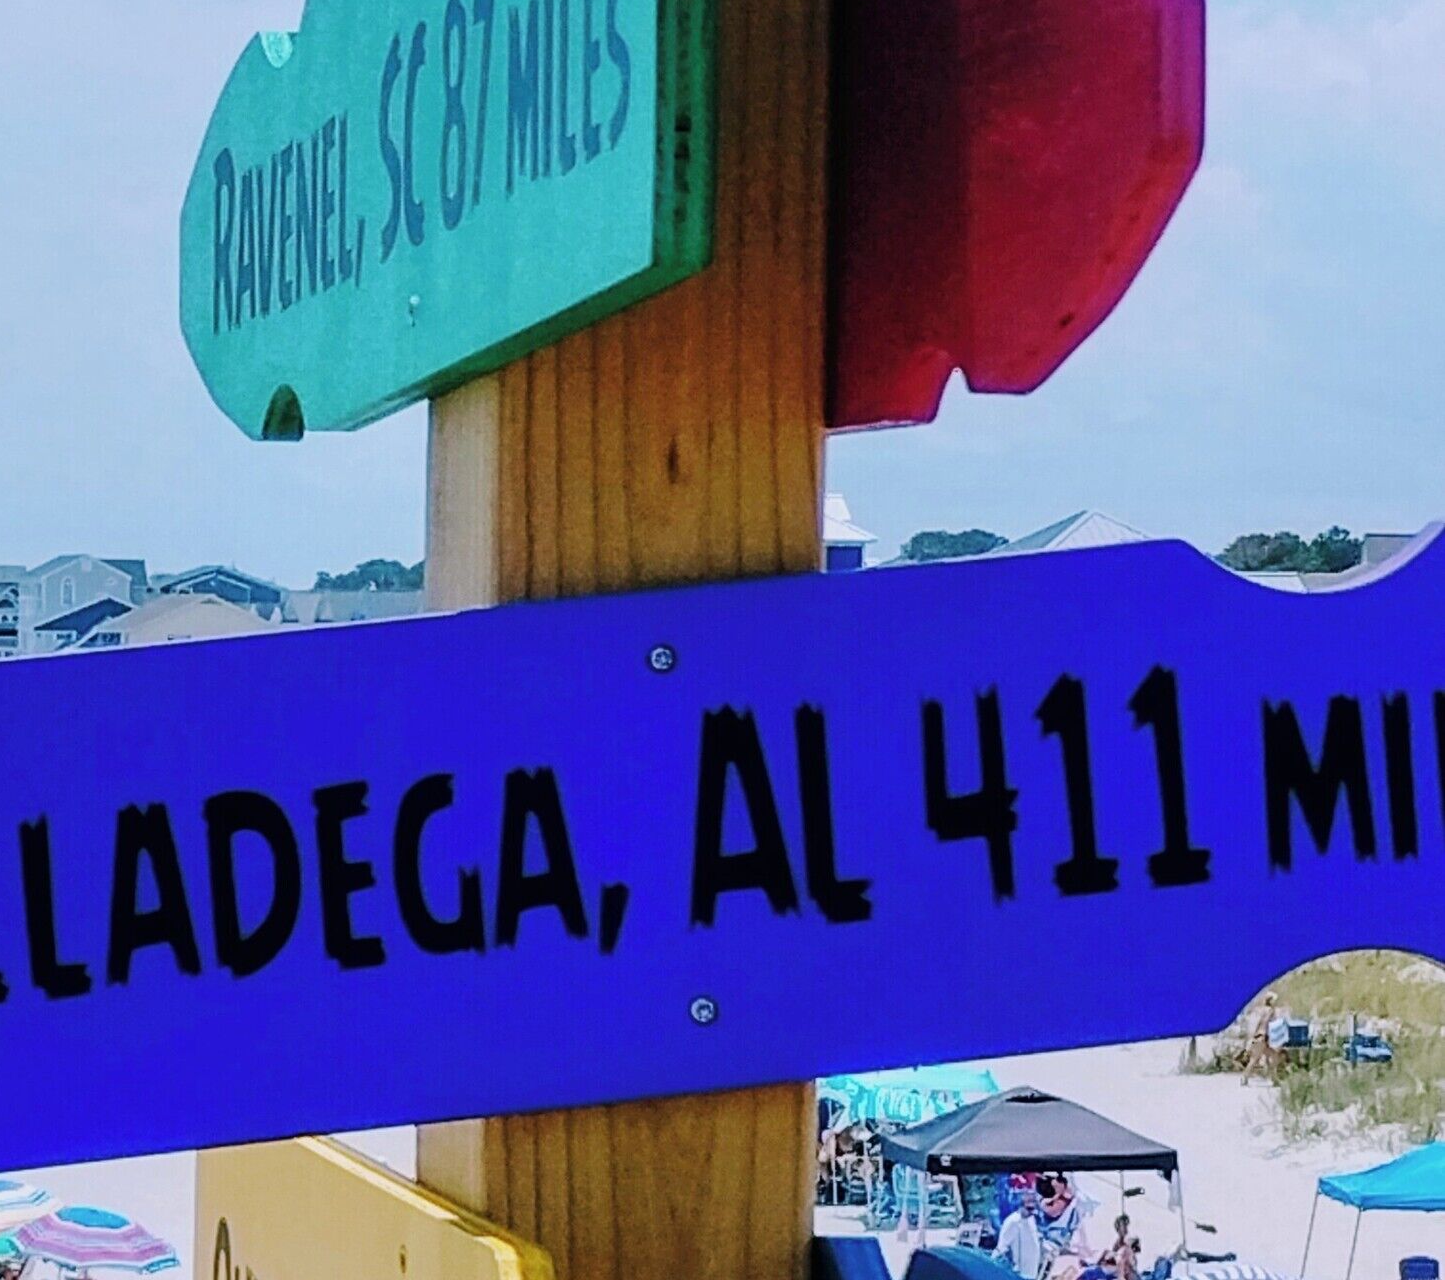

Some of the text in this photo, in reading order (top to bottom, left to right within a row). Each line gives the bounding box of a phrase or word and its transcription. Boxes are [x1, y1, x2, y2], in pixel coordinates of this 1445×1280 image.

[212, 109, 366, 336] RAVENEL,
[379, 21, 427, 264] SC
[690, 702, 874, 928] AL
[920, 664, 1211, 904] 411
[1261, 688, 1445, 874] MI
